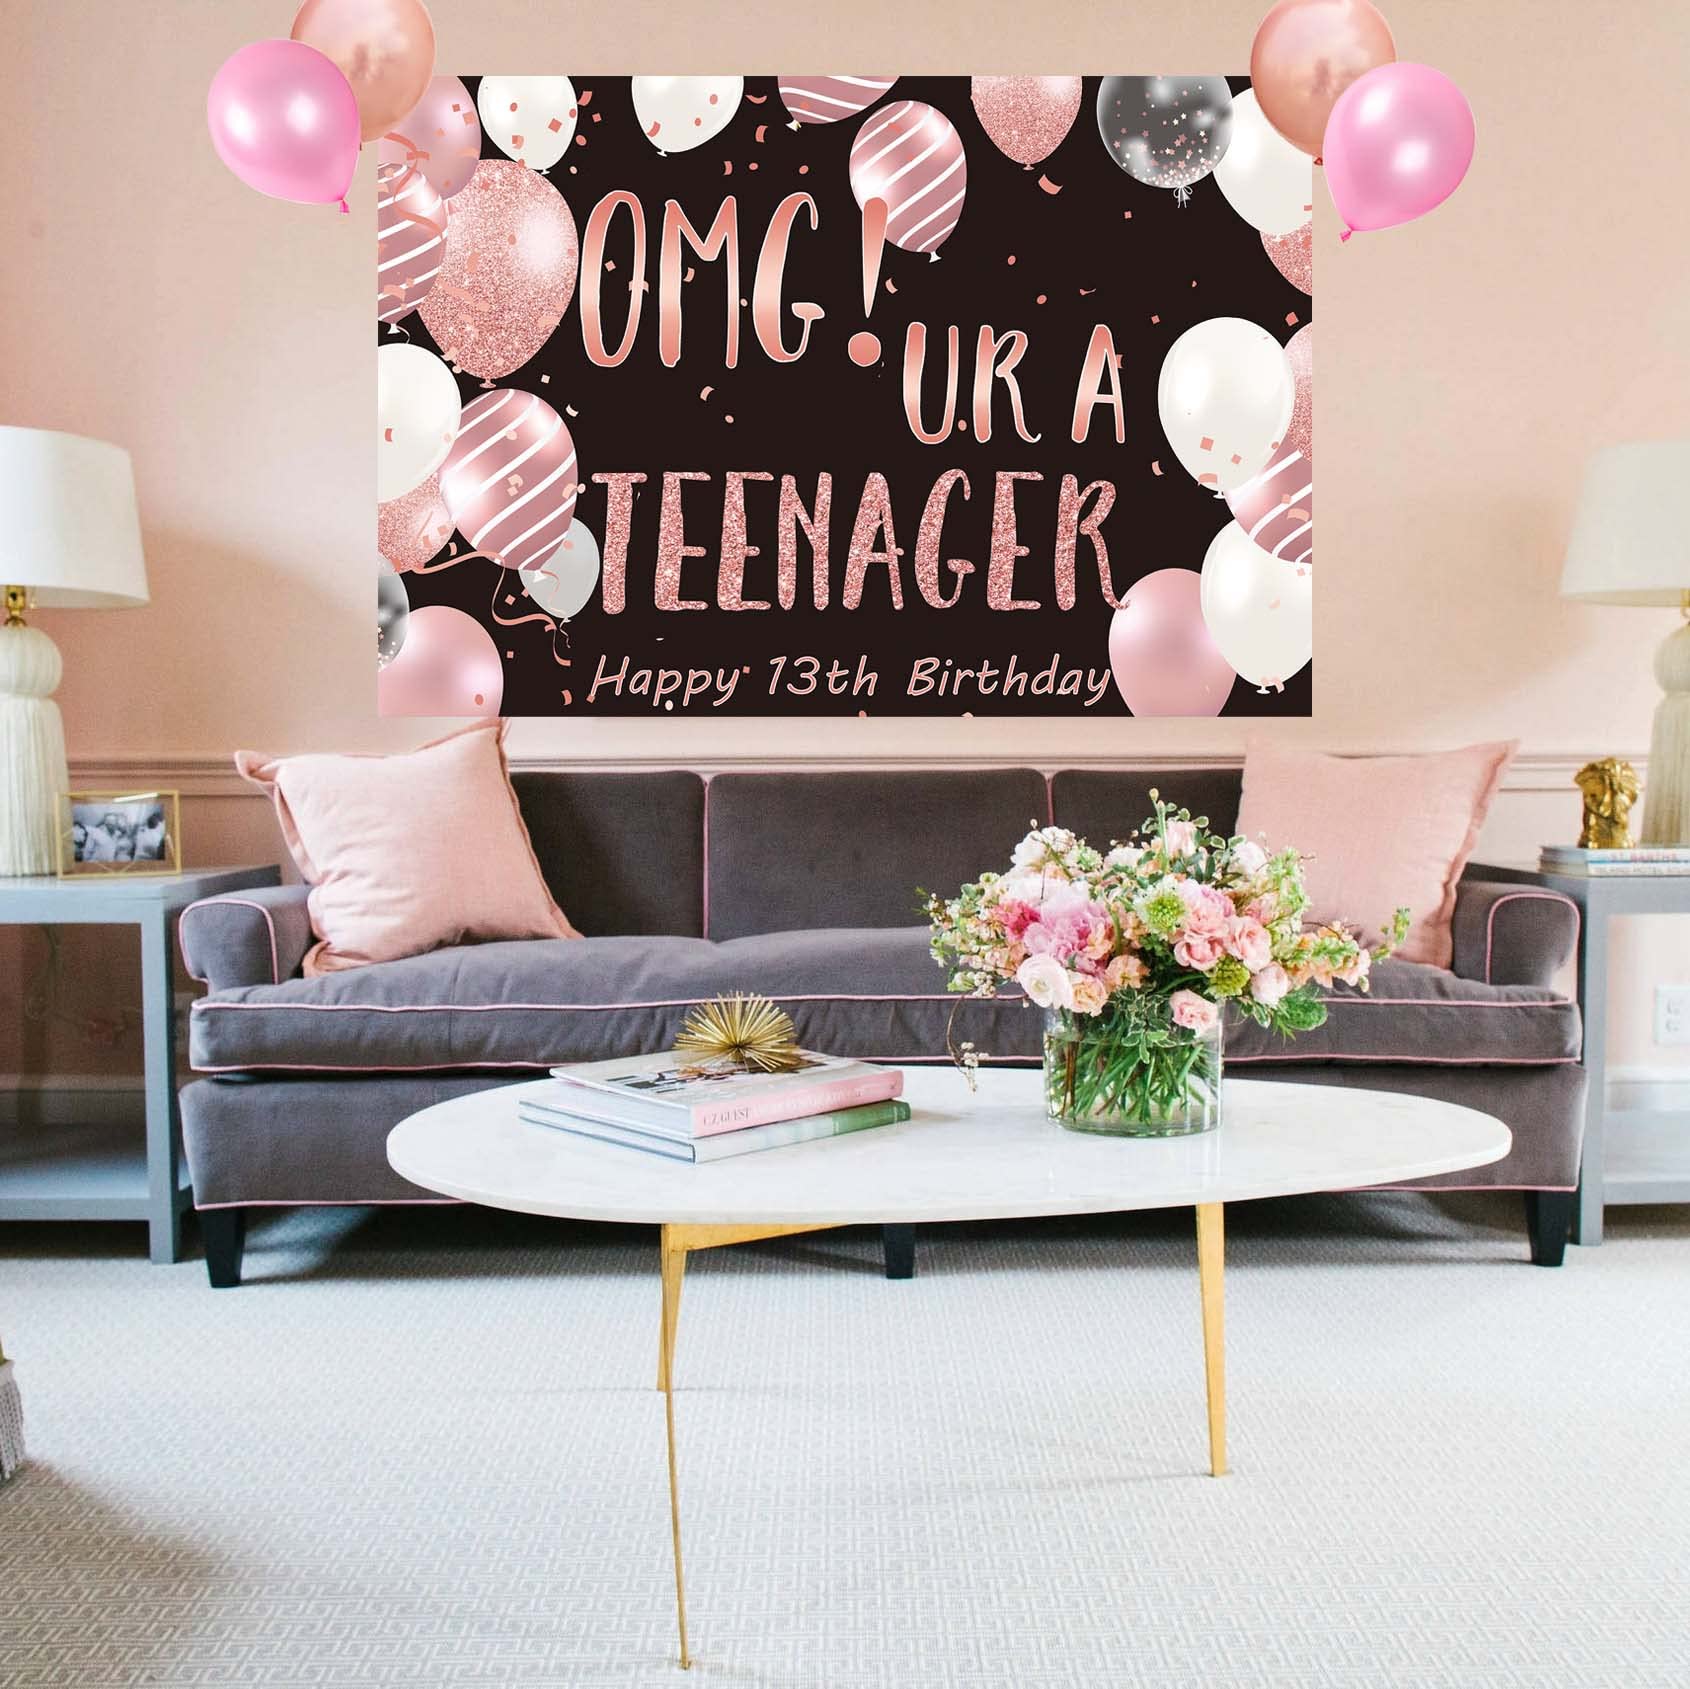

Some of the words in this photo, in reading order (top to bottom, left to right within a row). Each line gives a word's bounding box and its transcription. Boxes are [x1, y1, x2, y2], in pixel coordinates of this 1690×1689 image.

[579, 189, 888, 369] OMG!
[902, 321, 1042, 445] UR
[1070, 323, 1127, 444] A
[591, 467, 1131, 615] TEENAGER
[589, 653, 740, 706] Happy
[767, 654, 879, 697] 13th
[906, 653, 1111, 706] Birthday
